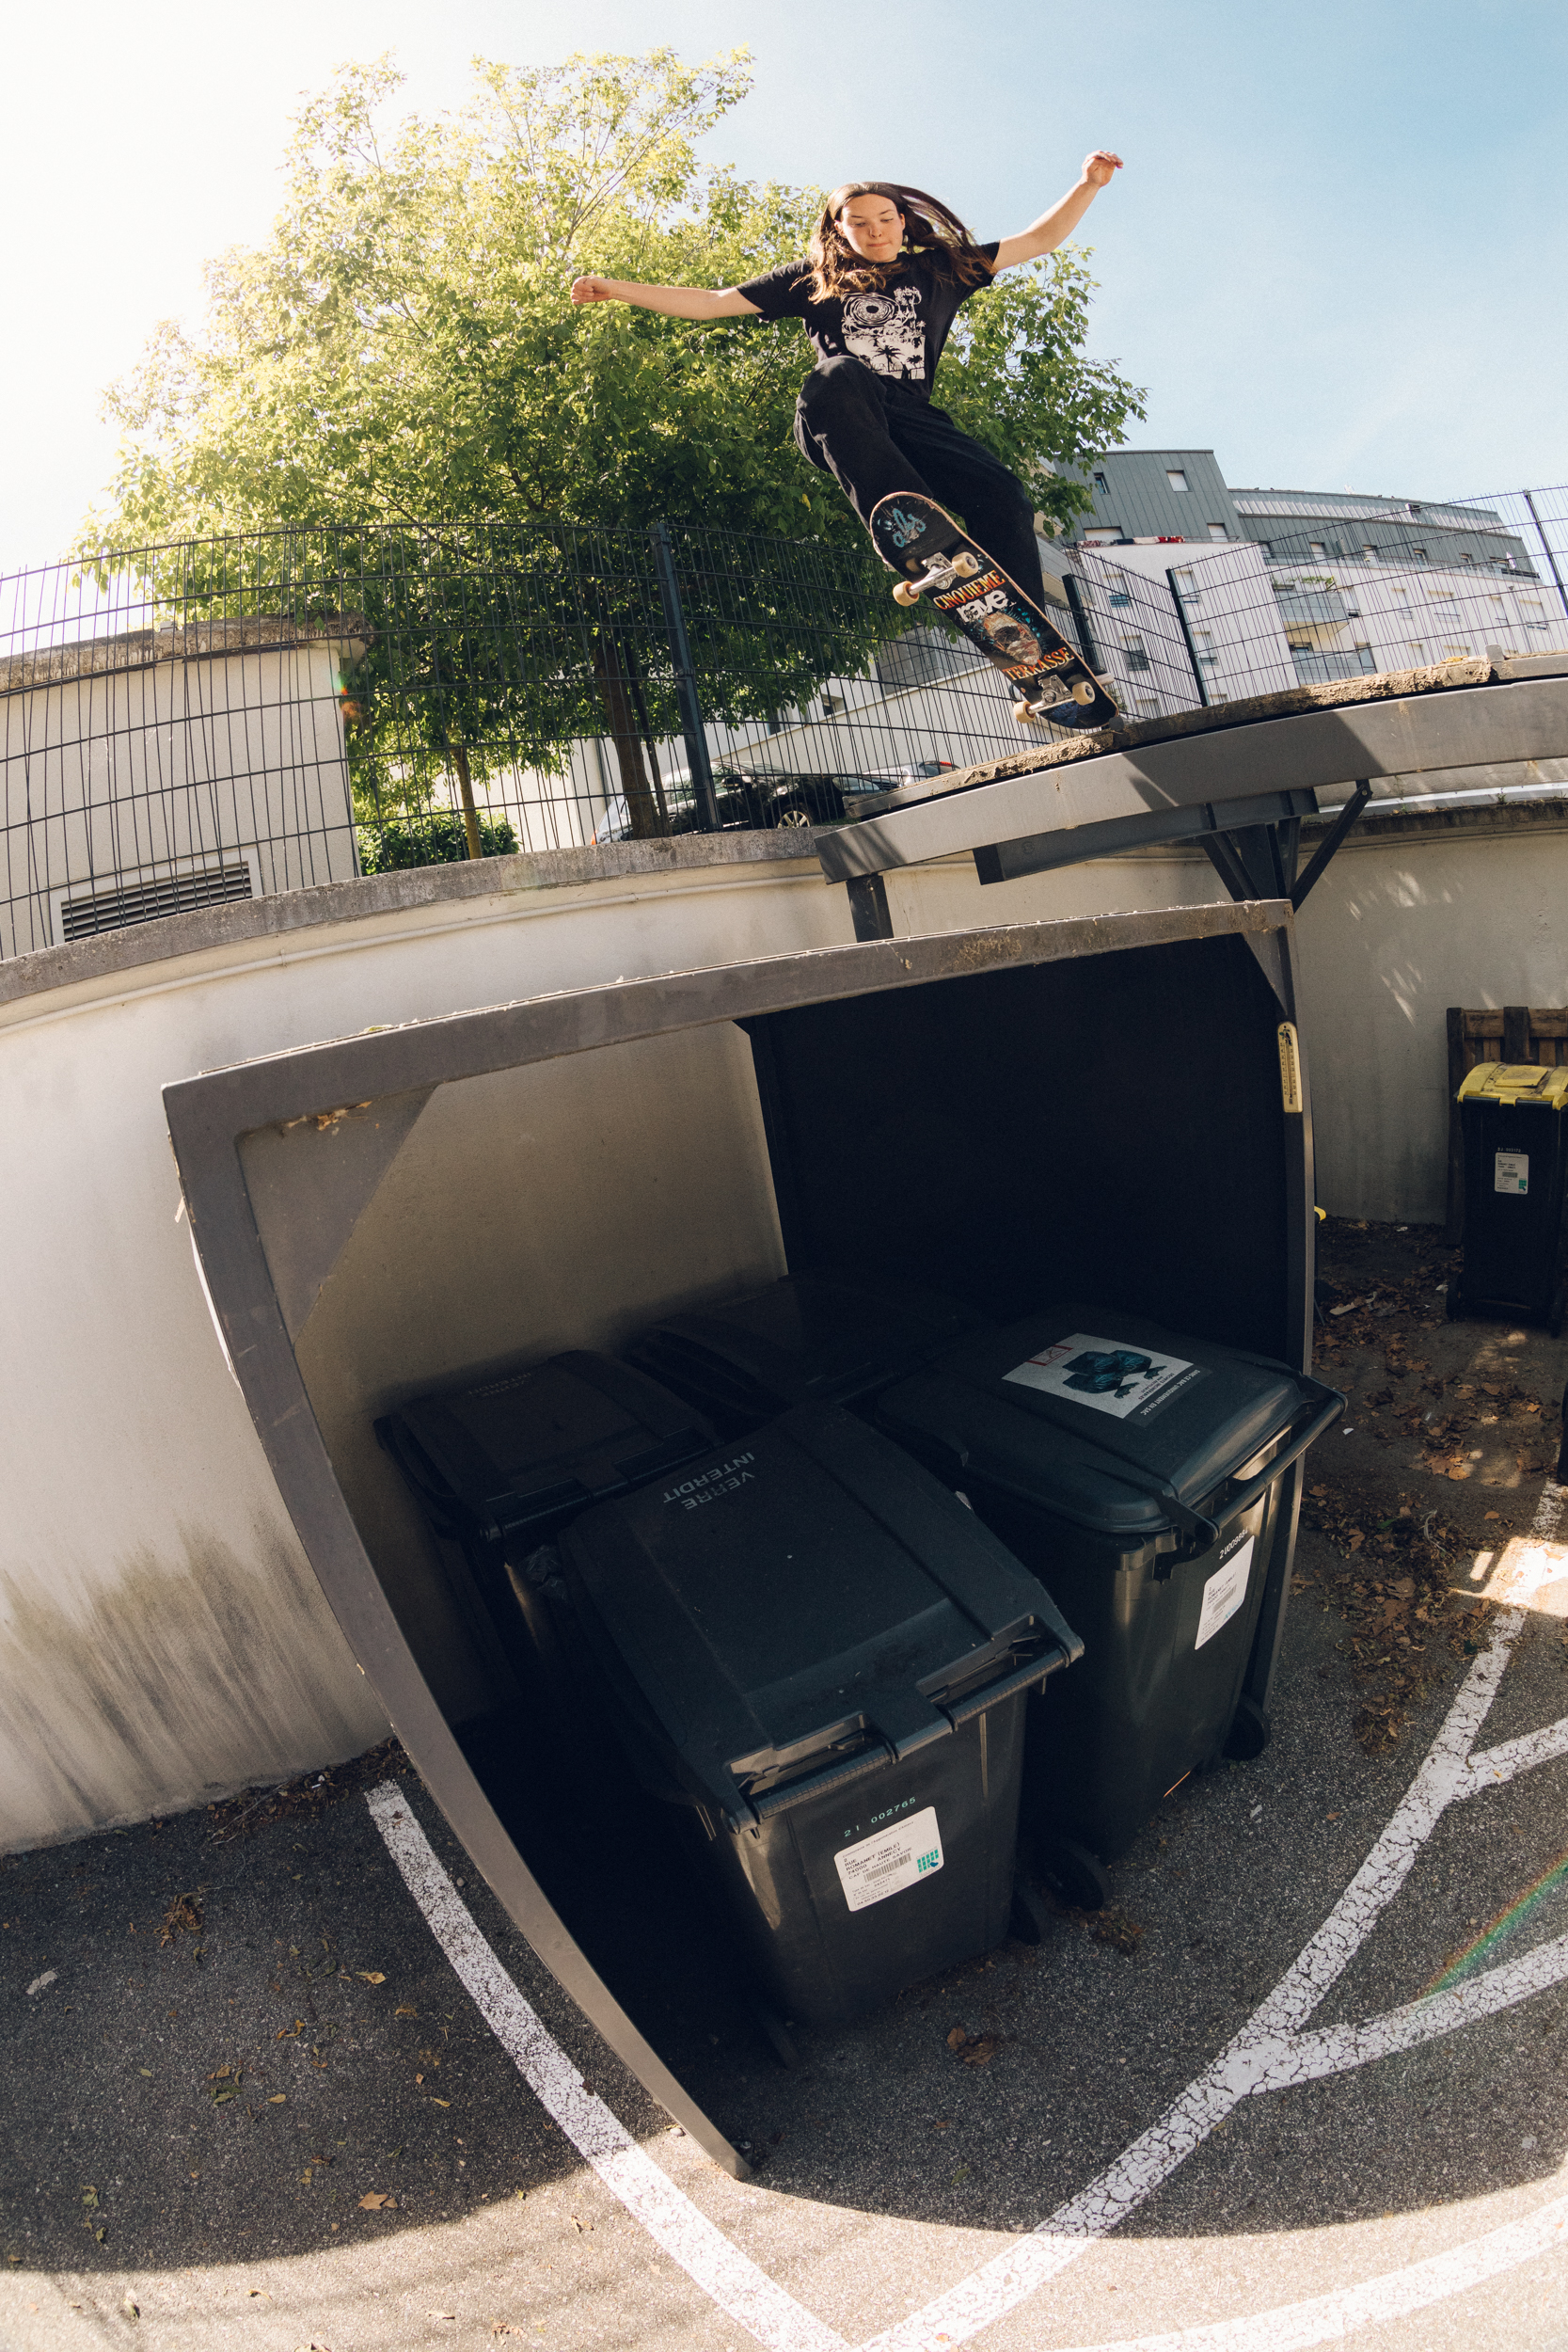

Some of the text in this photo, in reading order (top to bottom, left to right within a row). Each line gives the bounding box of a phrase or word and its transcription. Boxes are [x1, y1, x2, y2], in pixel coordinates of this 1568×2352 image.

[956, 590, 1009, 623] rave
[1002, 646, 1075, 681] TERRASSE
[662, 1452, 755, 1503] INTERDIT
[680, 1470, 755, 1510] VERRE
[844, 1858, 857, 1867] RUE
[846, 1854, 876, 1871] ROMANET
[847, 1864, 867, 1875] 74000
[877, 1847, 901, 1861] ANNECY
[871, 1858, 890, 1869] HAUTE
